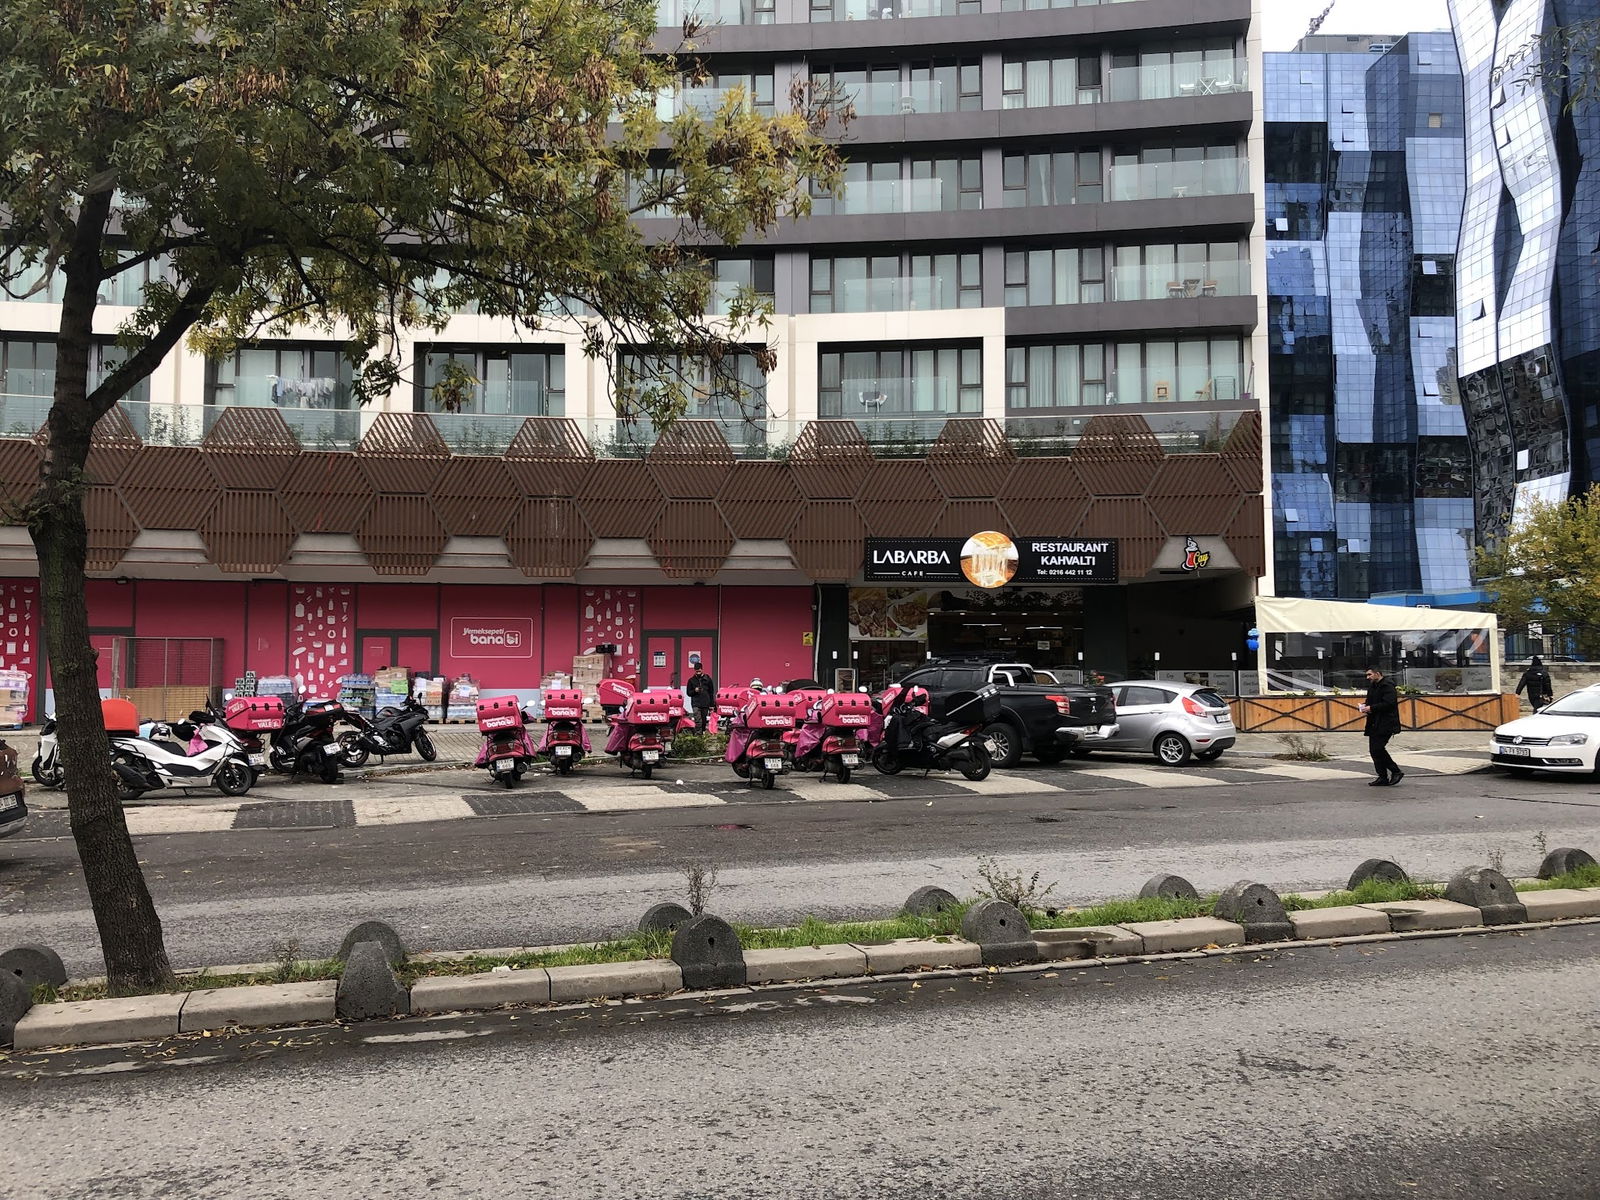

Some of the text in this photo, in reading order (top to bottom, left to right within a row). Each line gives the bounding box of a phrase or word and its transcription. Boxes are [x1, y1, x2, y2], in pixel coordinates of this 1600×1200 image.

[1031, 542, 1109, 553] RESTAURANT
[873, 550, 951, 564] LABARBA
[1041, 555, 1096, 566] KAHVALTI
